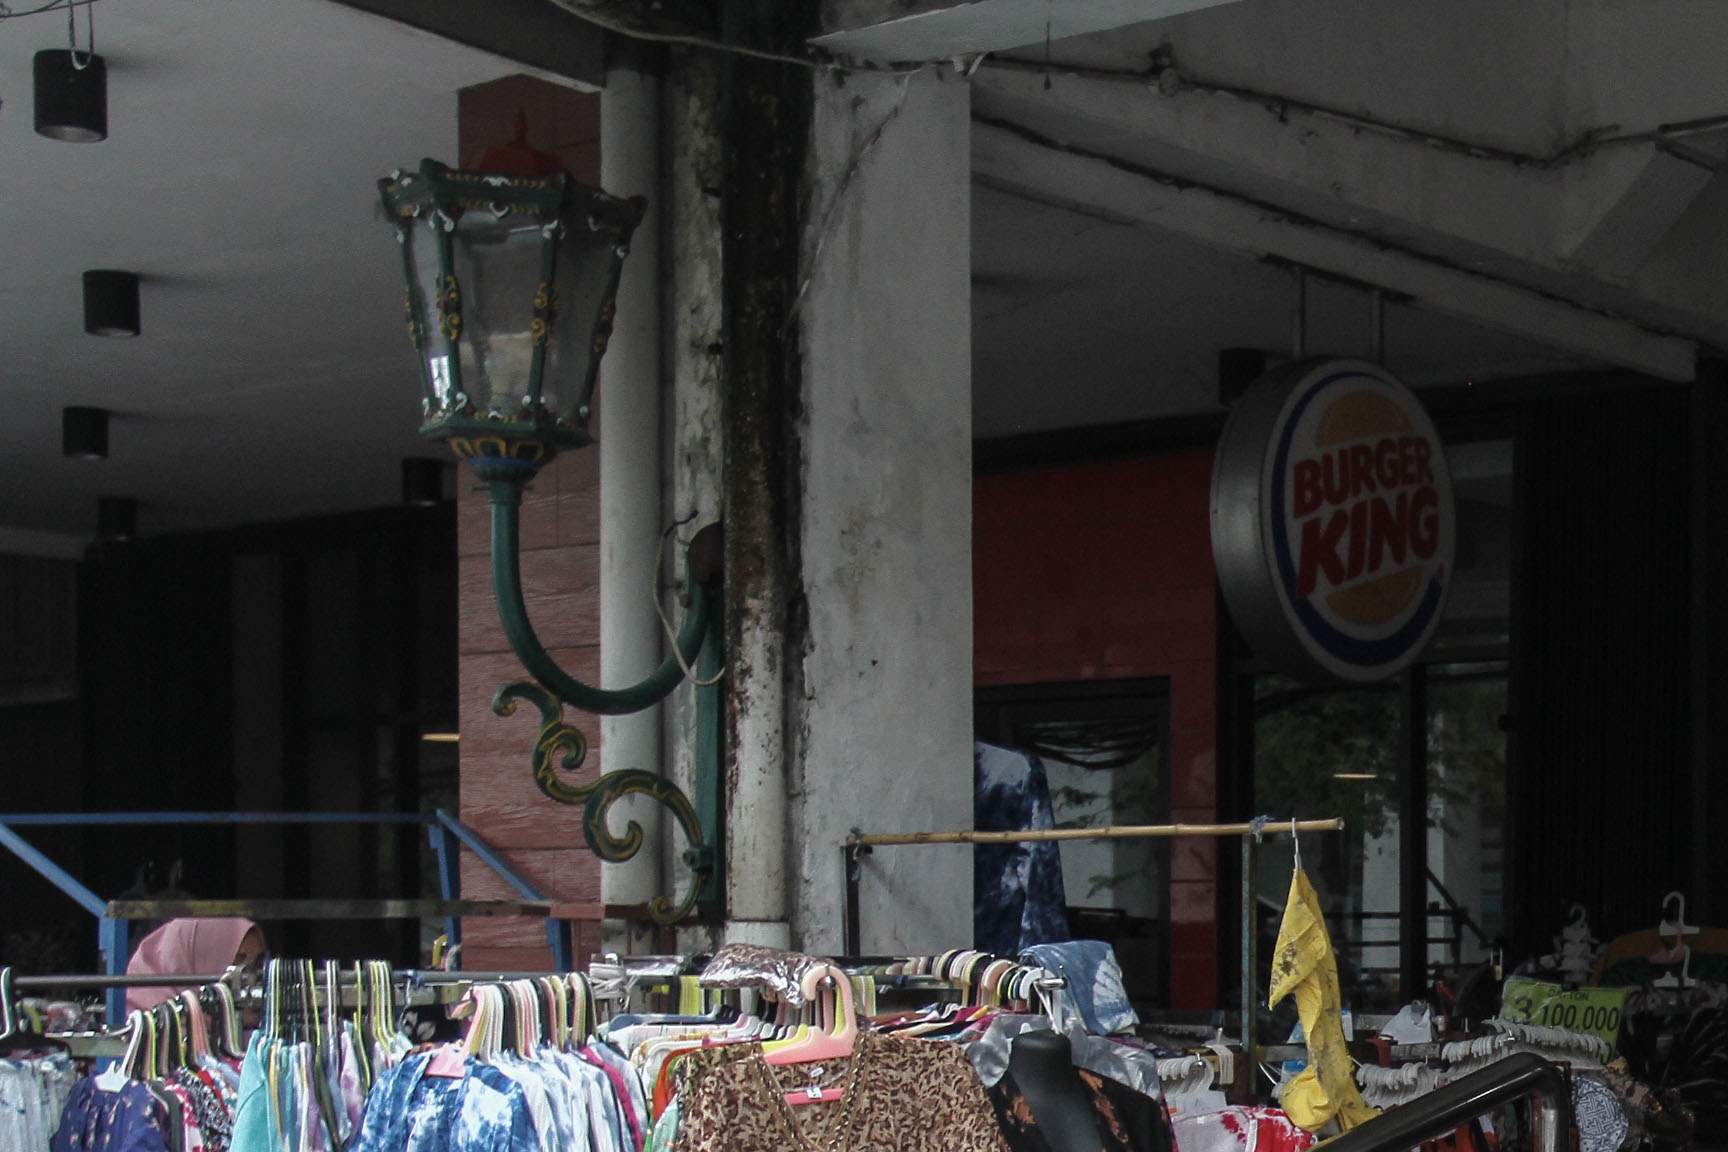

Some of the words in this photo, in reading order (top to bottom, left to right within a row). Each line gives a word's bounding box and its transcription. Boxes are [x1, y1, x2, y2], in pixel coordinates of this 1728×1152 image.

[1293, 437, 1434, 519] BURGER
[1295, 486, 1441, 598] KING
[1541, 1003, 1620, 1032] 100.000
